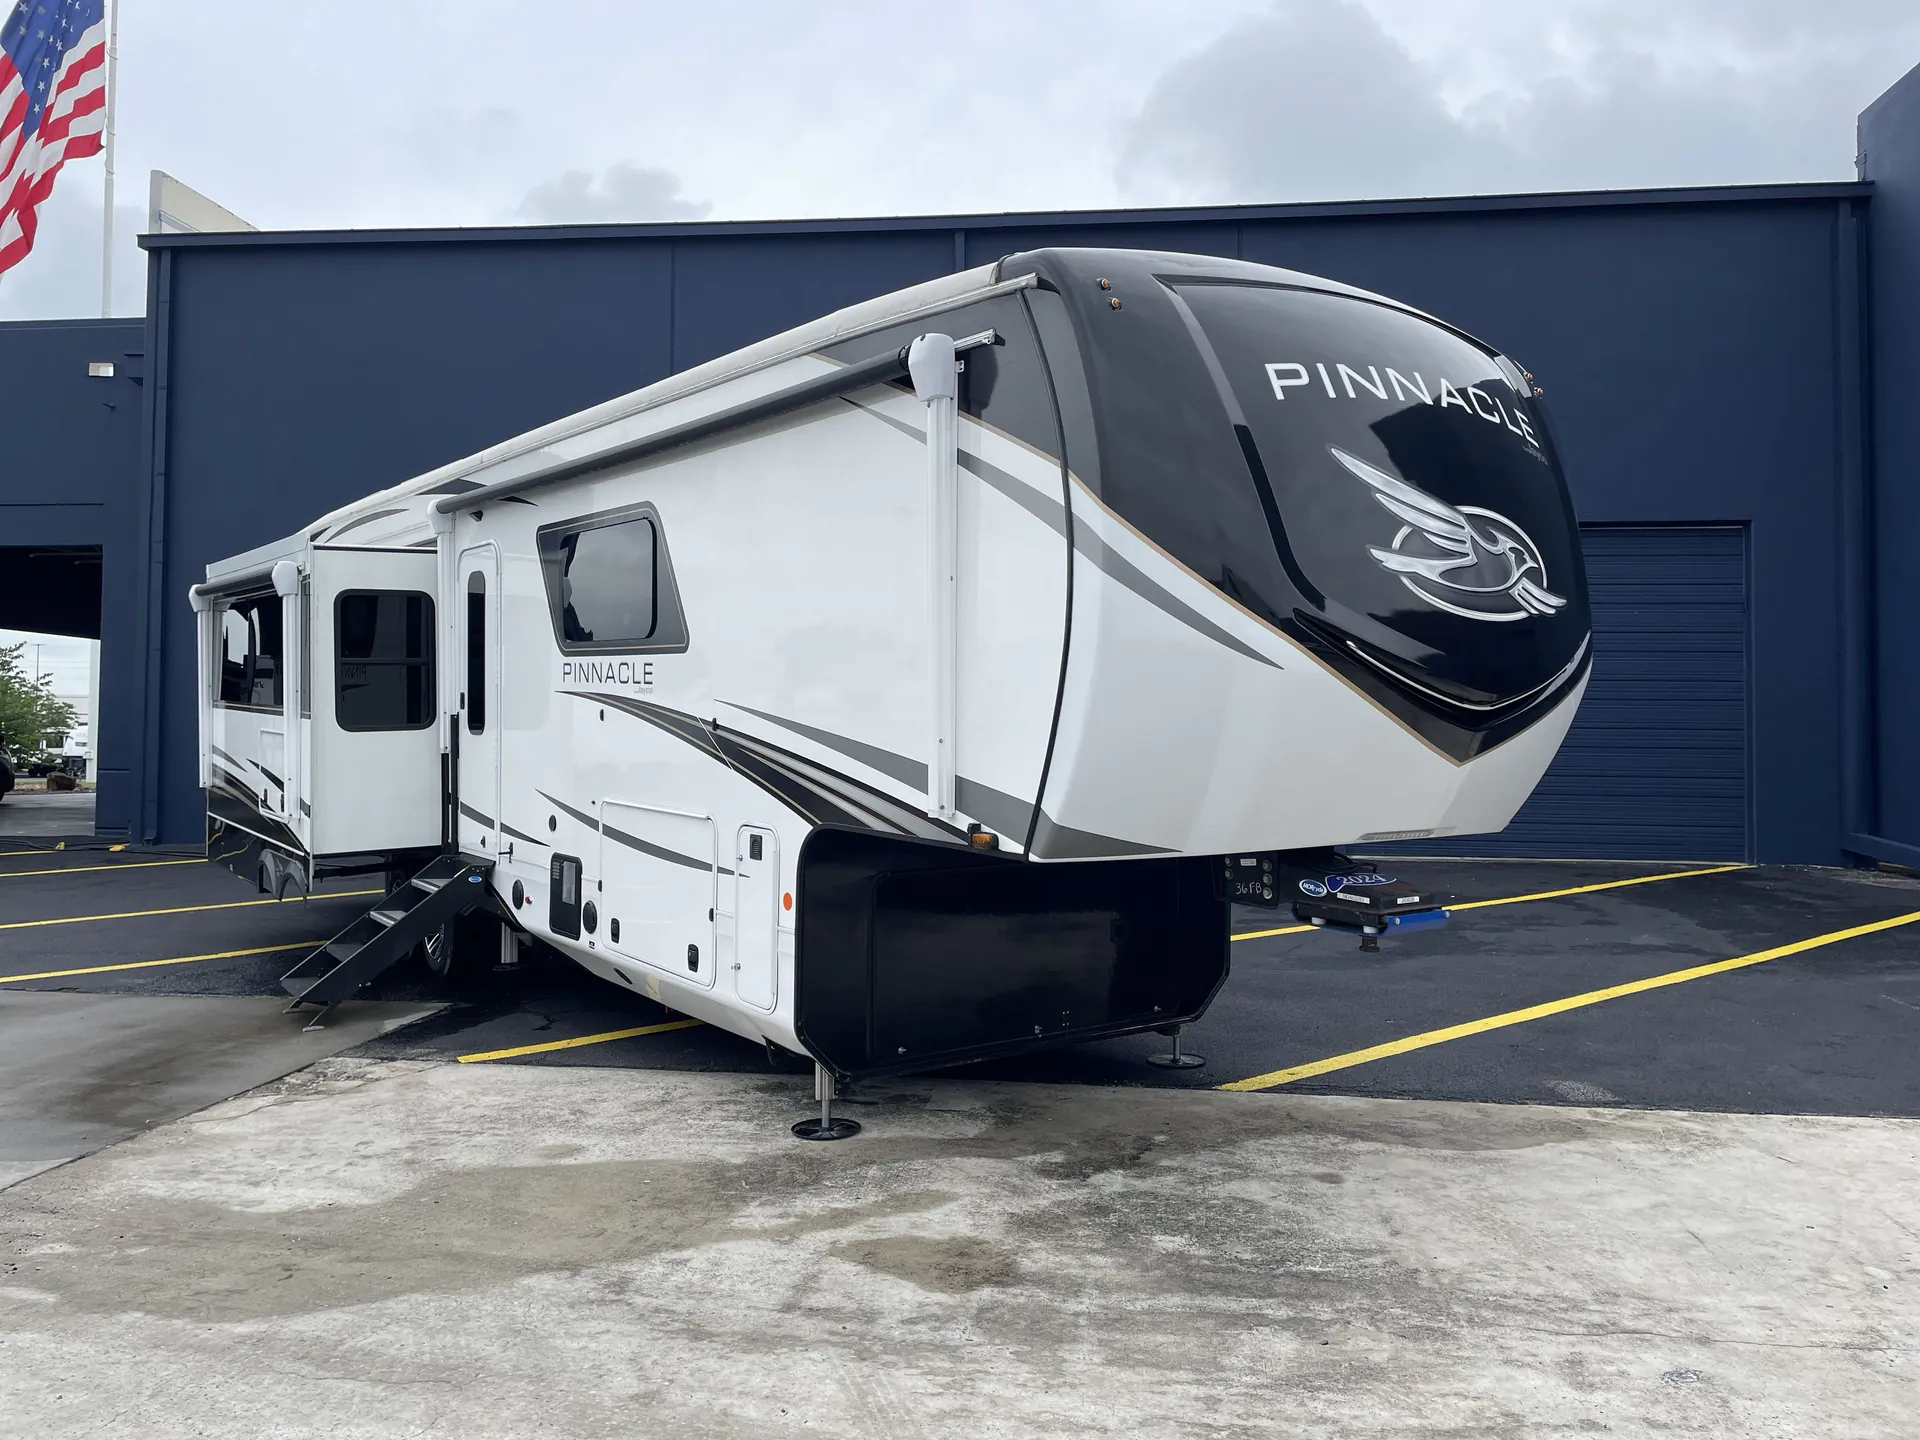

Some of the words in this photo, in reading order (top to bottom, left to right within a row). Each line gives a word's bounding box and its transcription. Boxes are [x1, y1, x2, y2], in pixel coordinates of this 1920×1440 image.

[1264, 362, 1540, 448] PINNACLE
[562, 662, 654, 685] PINNACLE
[638, 686, 654, 696] Jayco
[1336, 873, 1388, 885] 2024
[1235, 881, 1262, 895] 36FB
